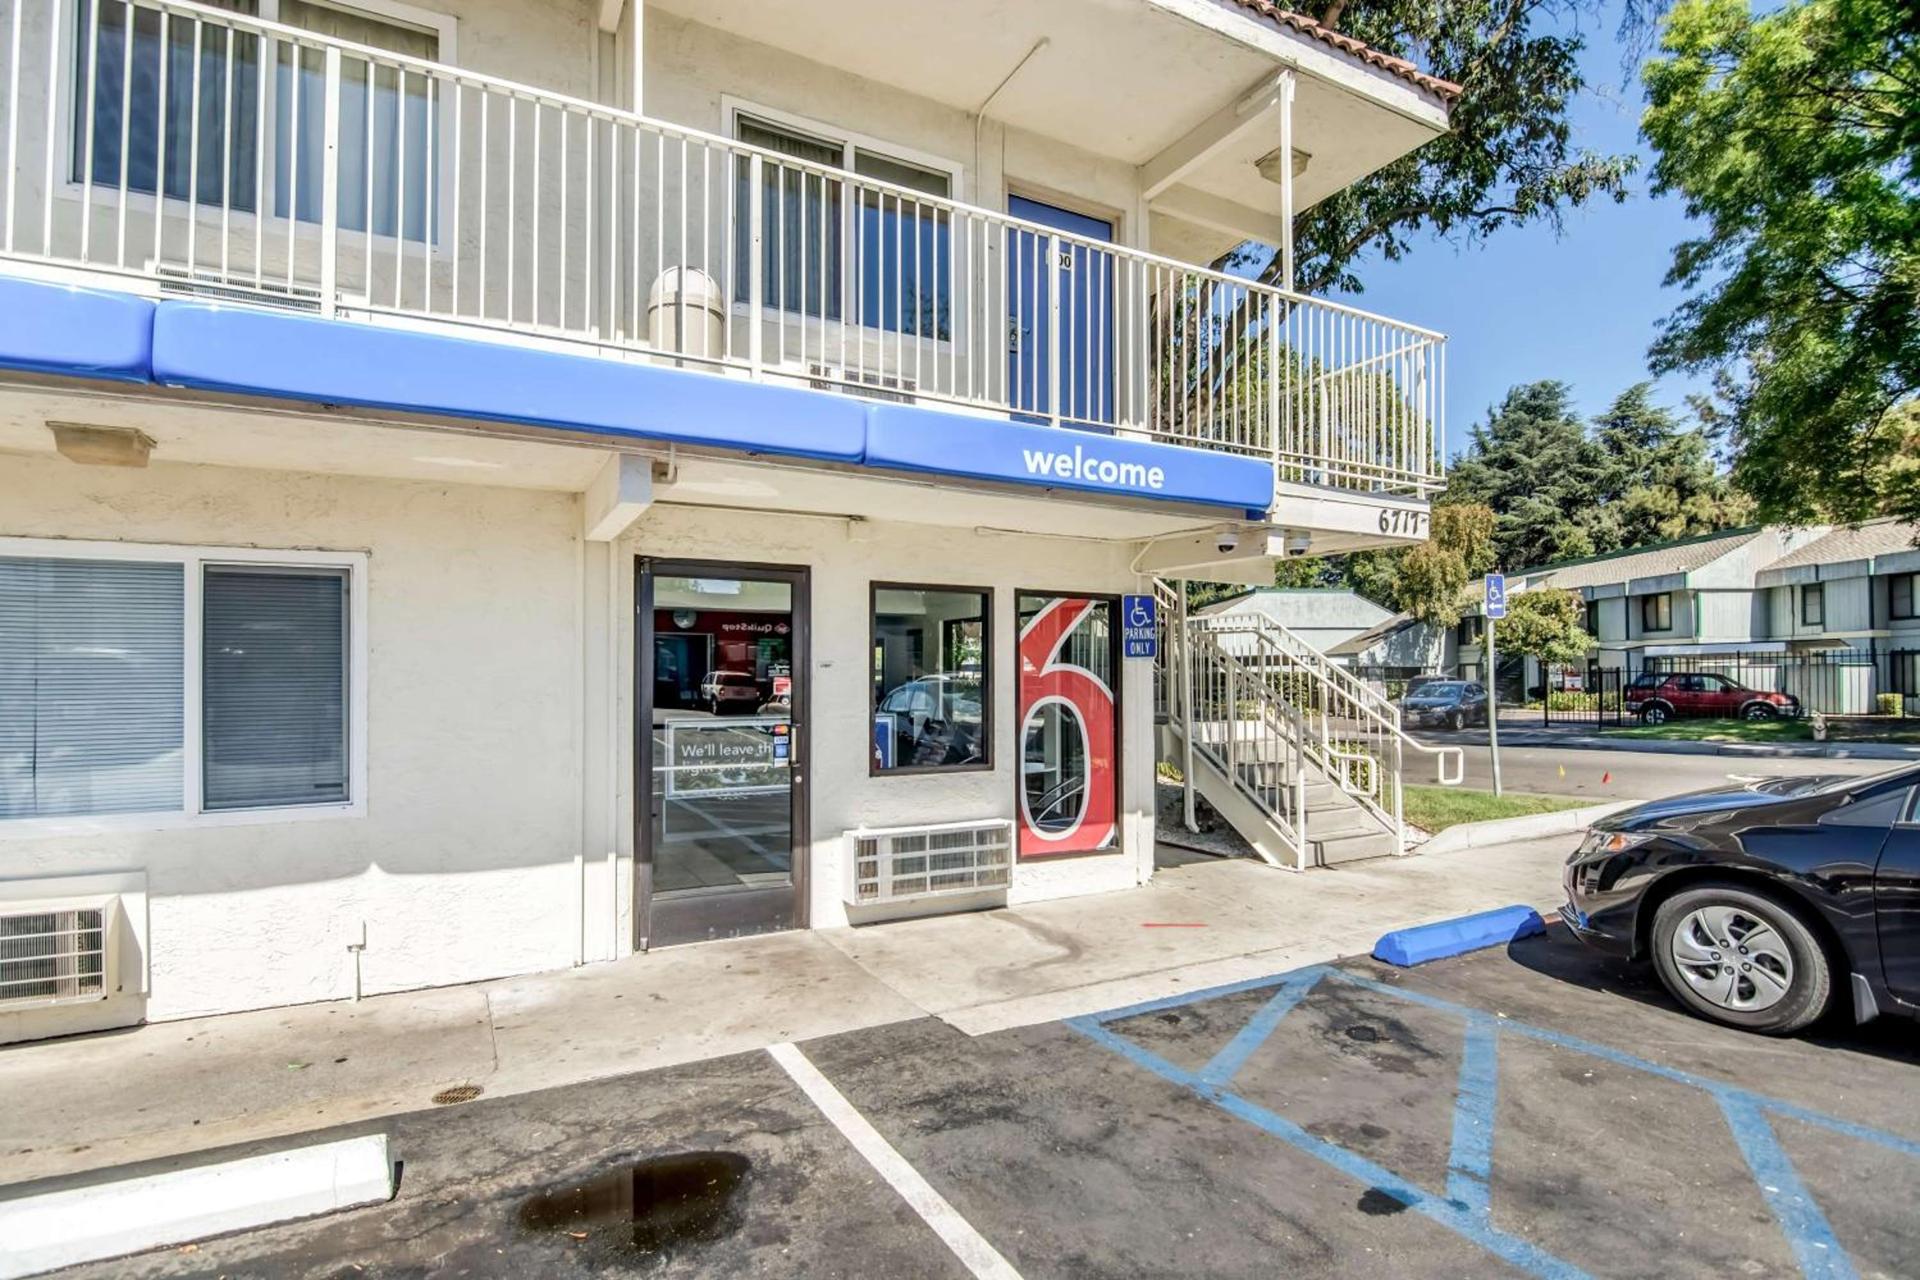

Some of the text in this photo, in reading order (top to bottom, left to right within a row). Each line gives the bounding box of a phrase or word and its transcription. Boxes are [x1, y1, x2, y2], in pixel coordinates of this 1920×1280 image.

[1023, 446, 1165, 489] welcome
[1124, 627, 1155, 640] PARKING
[1130, 641, 1150, 655] ONLY
[681, 744, 715, 757] We'll
[720, 744, 754, 756] leave
[758, 742, 774, 754] th
